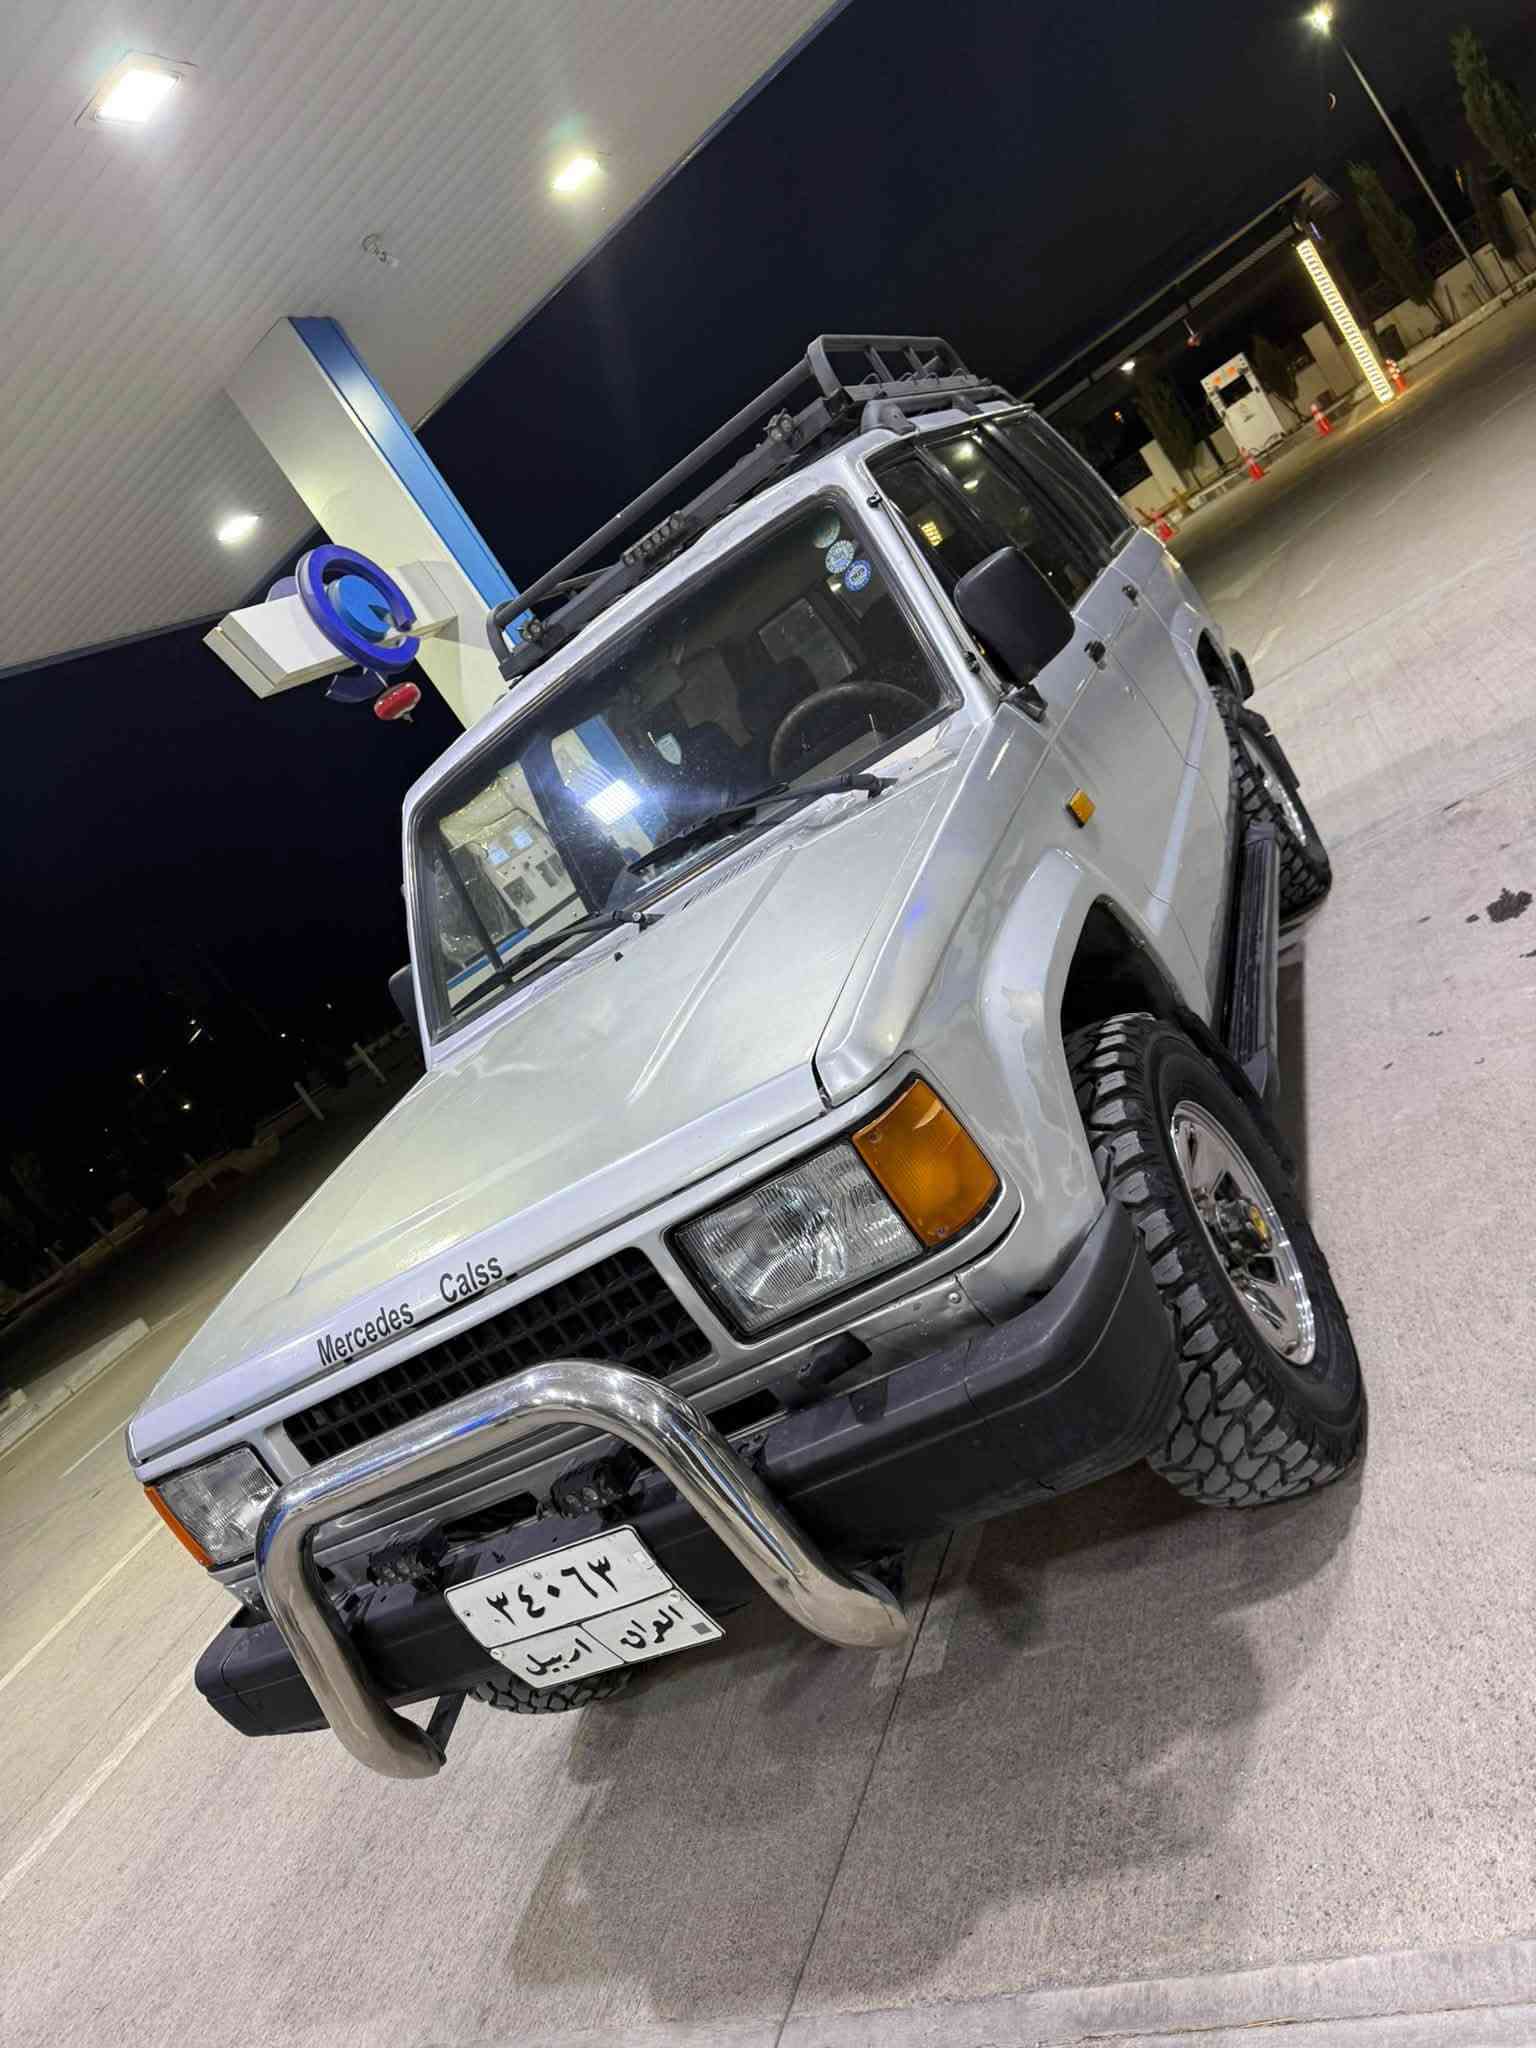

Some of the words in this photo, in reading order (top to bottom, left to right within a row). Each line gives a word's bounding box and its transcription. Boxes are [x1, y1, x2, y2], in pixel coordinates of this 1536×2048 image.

[316, 1302, 414, 1366] Mercedes
[439, 1256, 504, 1303] Calss
[486, 1555, 618, 1626] ٣٤٠٦٣
